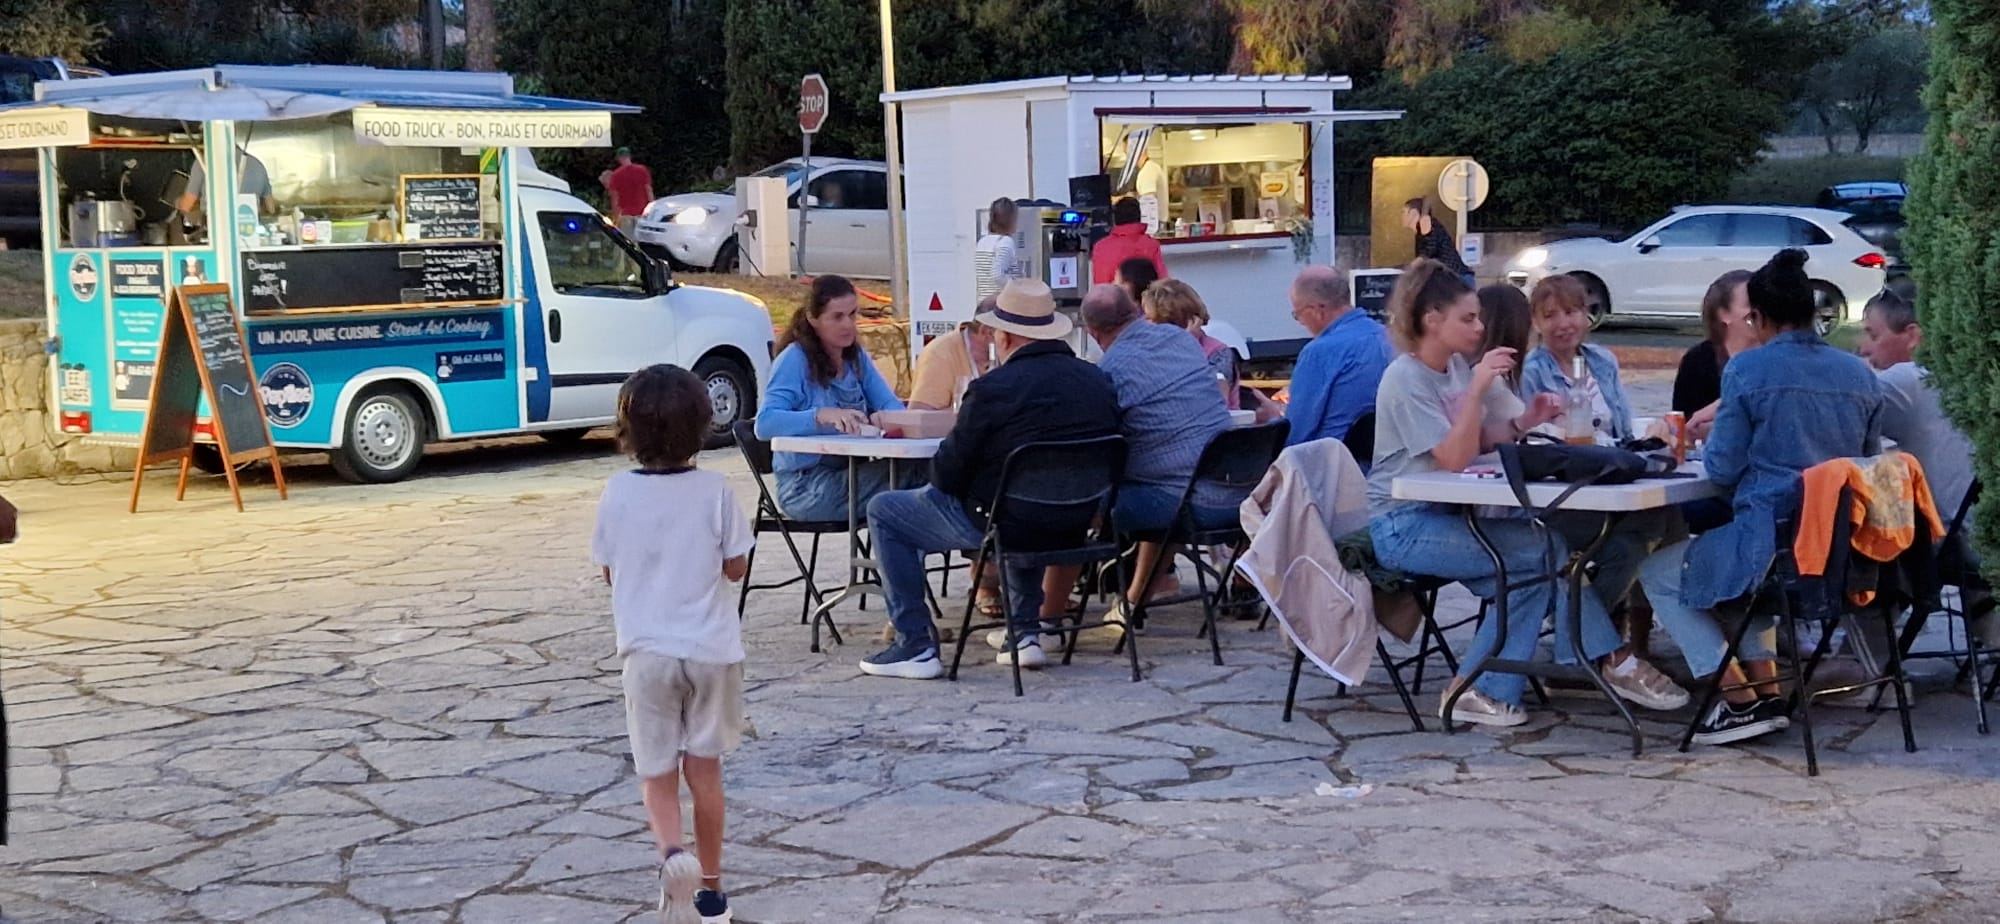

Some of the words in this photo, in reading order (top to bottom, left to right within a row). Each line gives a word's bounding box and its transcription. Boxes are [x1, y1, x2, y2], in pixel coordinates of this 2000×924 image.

[799, 95, 824, 113] STOP
[18, 120, 68, 138] GOURMAND
[364, 120, 401, 137] FOOD
[404, 121, 446, 139] TRUCK
[488, 123, 520, 139] FRAIS
[523, 123, 538, 139] ET
[540, 123, 603, 139] GOURMAND
[257, 330, 275, 345] UN
[276, 329, 313, 345] JOUR,
[313, 327, 336, 342] UNE
[386, 321, 424, 338] Street
[424, 319, 445, 336] Art
[446, 317, 491, 339] Cooking
